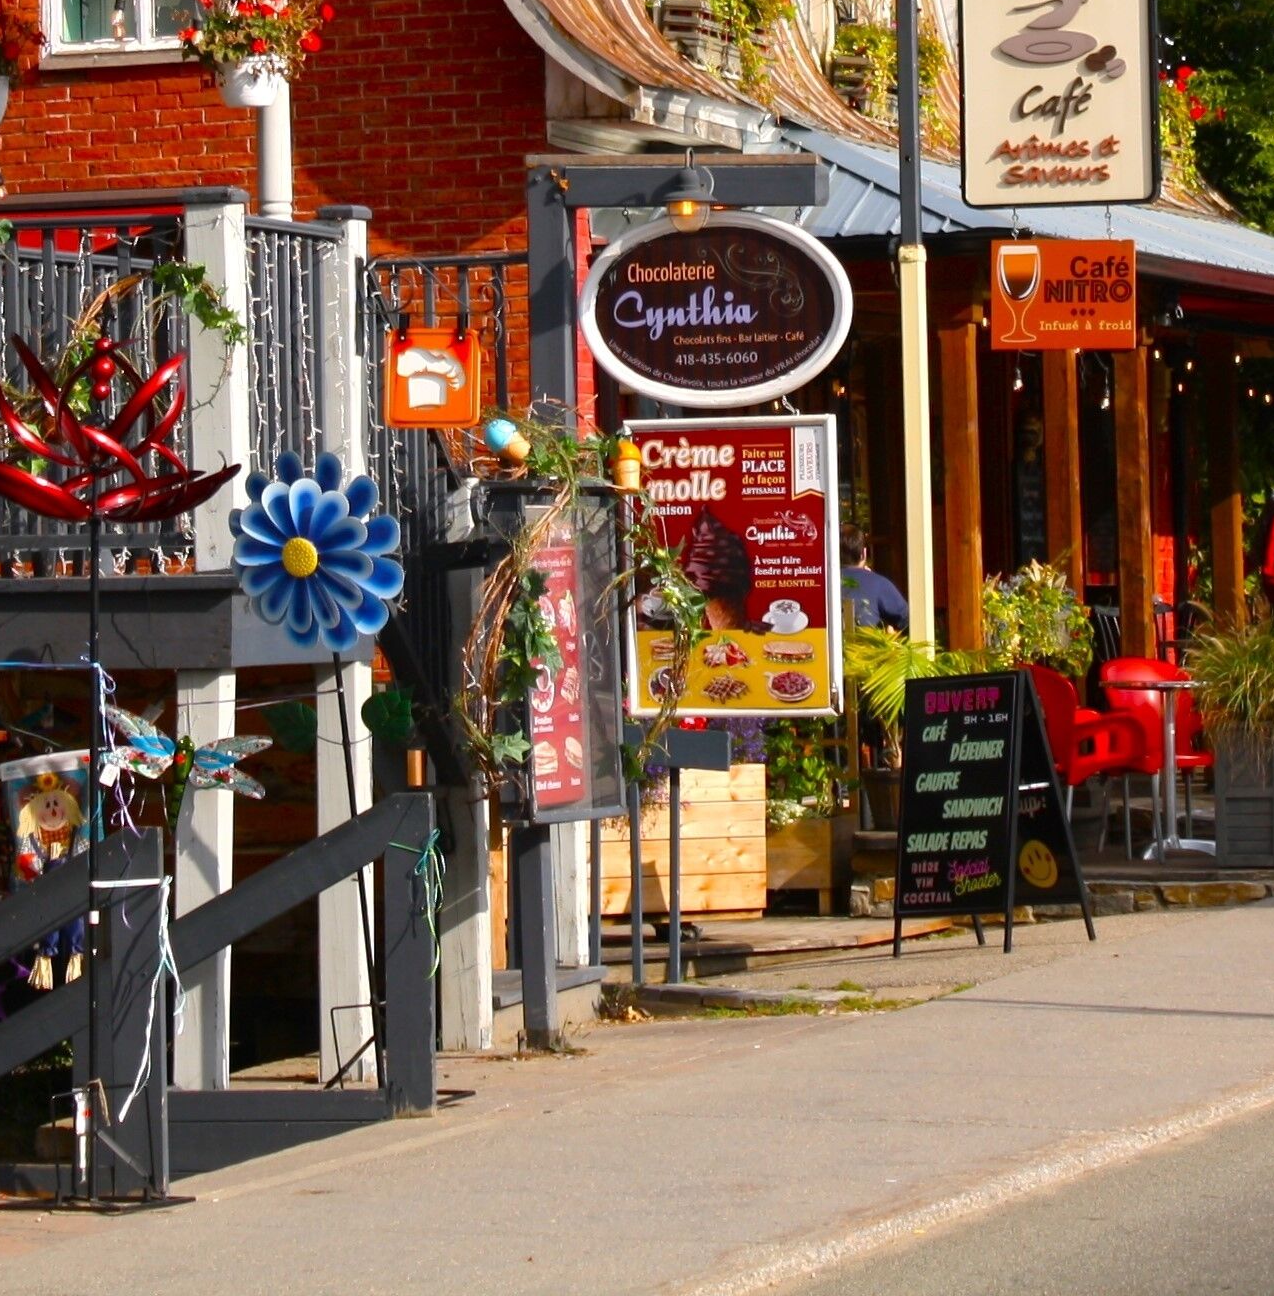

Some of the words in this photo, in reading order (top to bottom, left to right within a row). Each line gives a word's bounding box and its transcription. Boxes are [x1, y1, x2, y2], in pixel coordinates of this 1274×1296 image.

[1017, 76, 1093, 134] Café
[996, 134, 1091, 161] Arômes
[1099, 134, 1120, 157] et
[628, 260, 715, 283] Chocolaterie
[1070, 256, 1129, 278] Café
[1044, 279, 1133, 303] NITRO
[613, 285, 758, 341] Cynthia
[1039, 320, 1079, 331] Infusé
[1085, 320, 1092, 330] à
[1099, 320, 1132, 331] froid
[673, 335, 715, 346] Chocolats
[716, 333, 732, 344] fins
[738, 333, 752, 343] Bar
[754, 333, 778, 343] laitier
[785, 331, 805, 342] Café
[675, 351, 758, 366] 418-435-6060
[641, 437, 735, 469] Crème
[742, 449, 765, 459] Faite
[768, 450, 785, 459] sur
[742, 460, 786, 473] PLACE
[647, 470, 727, 502] molle
[741, 487, 786, 495] ARTISANALE
[742, 475, 754, 484] de
[757, 475, 786, 486] façon
[745, 525, 797, 545] Cynthia
[754, 566, 781, 576] fondre
[783, 566, 793, 575] de
[782, 556, 801, 565] faire
[755, 579, 777, 588] OSEZ
[925, 687, 1000, 715] OUVERT
[964, 715, 977, 724] 9H
[922, 718, 948, 743] CAFÉ
[949, 734, 1005, 763] DÉJEUNER
[916, 771, 961, 793] GAUFRE
[942, 796, 1004, 819] SANDWICH
[907, 831, 950, 853] SALADE
[950, 830, 988, 851] REPAS
[915, 877, 934, 889] VIN
[903, 892, 952, 904] COCKTAIL
